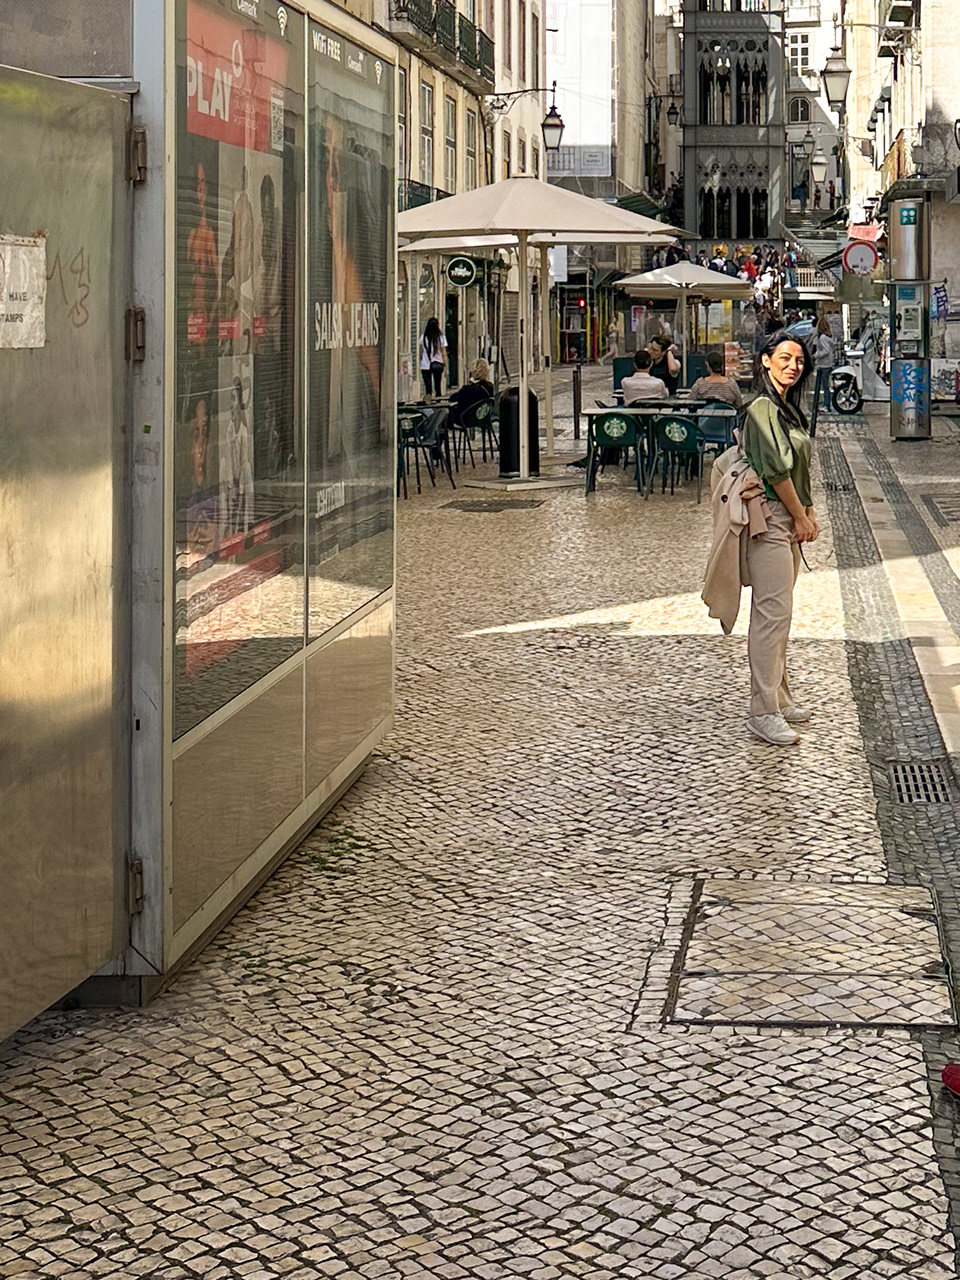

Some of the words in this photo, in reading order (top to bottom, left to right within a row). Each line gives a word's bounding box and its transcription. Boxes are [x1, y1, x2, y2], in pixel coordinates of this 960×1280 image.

[312, 29, 327, 55] WiFi
[327, 37, 341, 62] FREE
[186, 55, 233, 122] PLAY
[8, 291, 28, 302] HAVE
[314, 301, 343, 351] SALSA
[346, 301, 379, 349] JEANS
